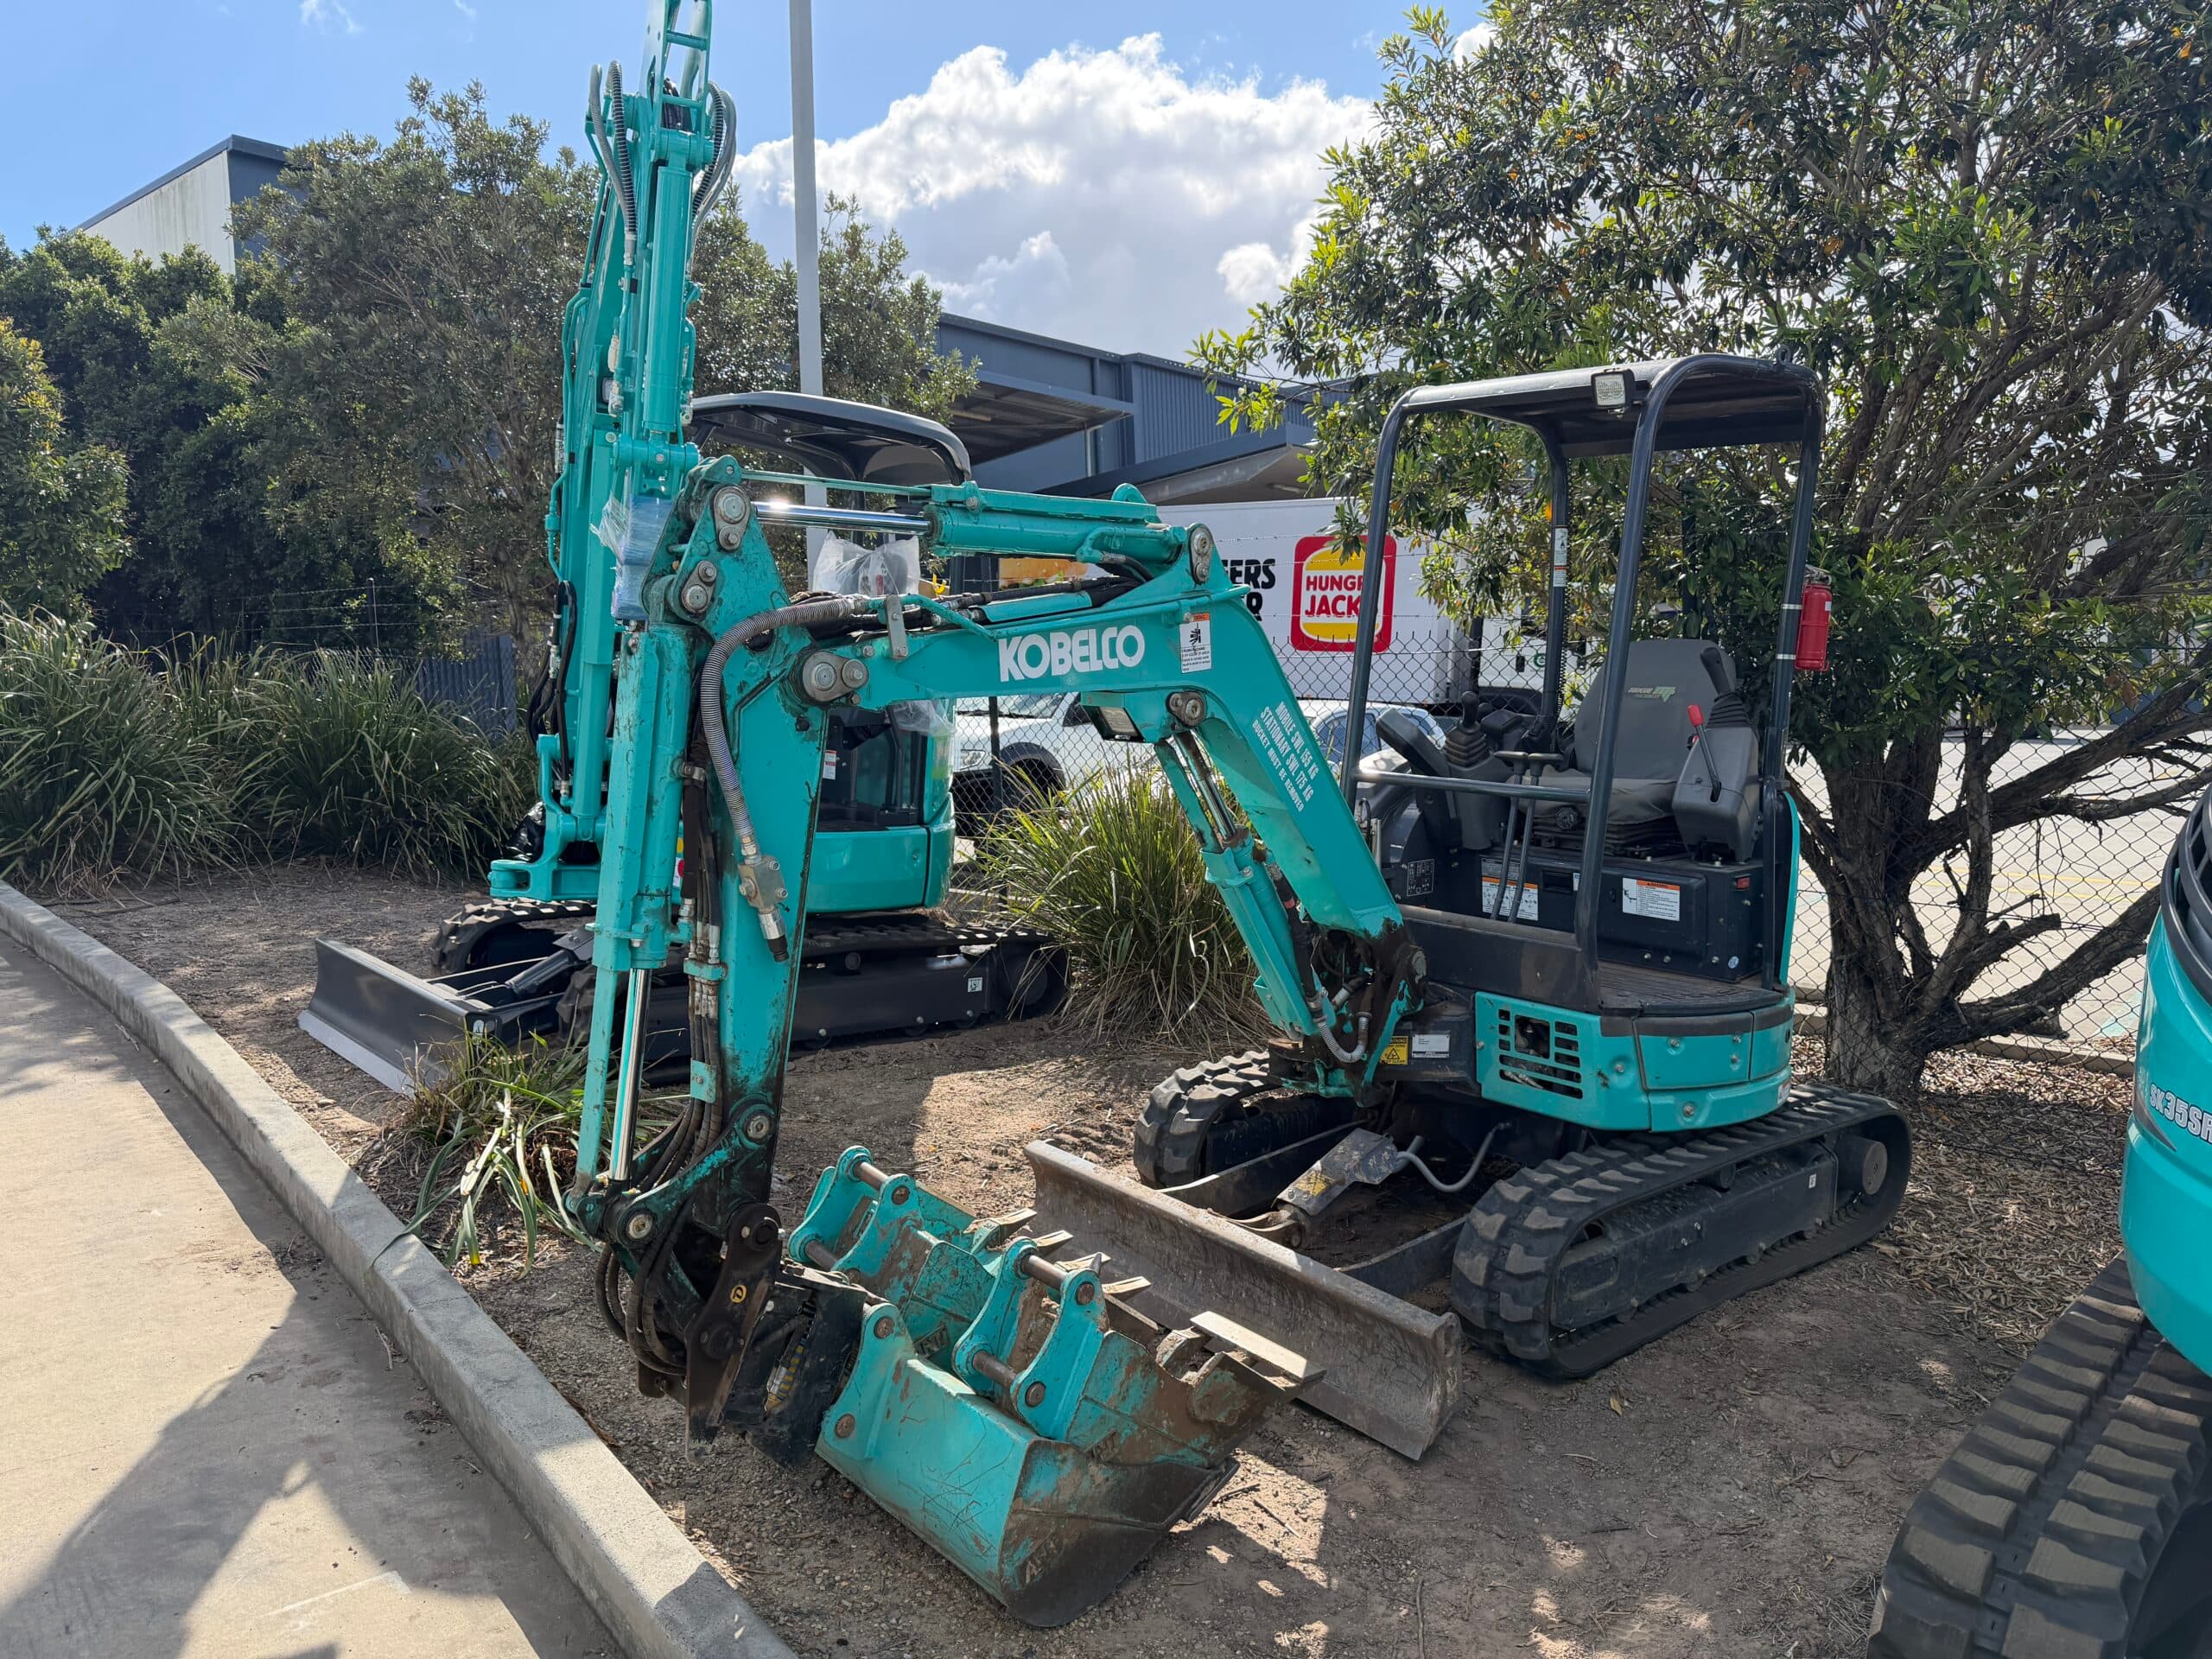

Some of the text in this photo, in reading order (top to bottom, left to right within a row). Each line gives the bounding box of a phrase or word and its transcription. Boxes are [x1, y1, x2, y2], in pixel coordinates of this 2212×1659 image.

[998, 625, 1146, 683] KOBELCO
[1252, 719, 1305, 812] BUCKET MUST BE REMOVED
[1261, 706, 1314, 802] STATIONARY SWL 175 KG
[1274, 701, 1319, 780] MOBILE SWL 155 KG
